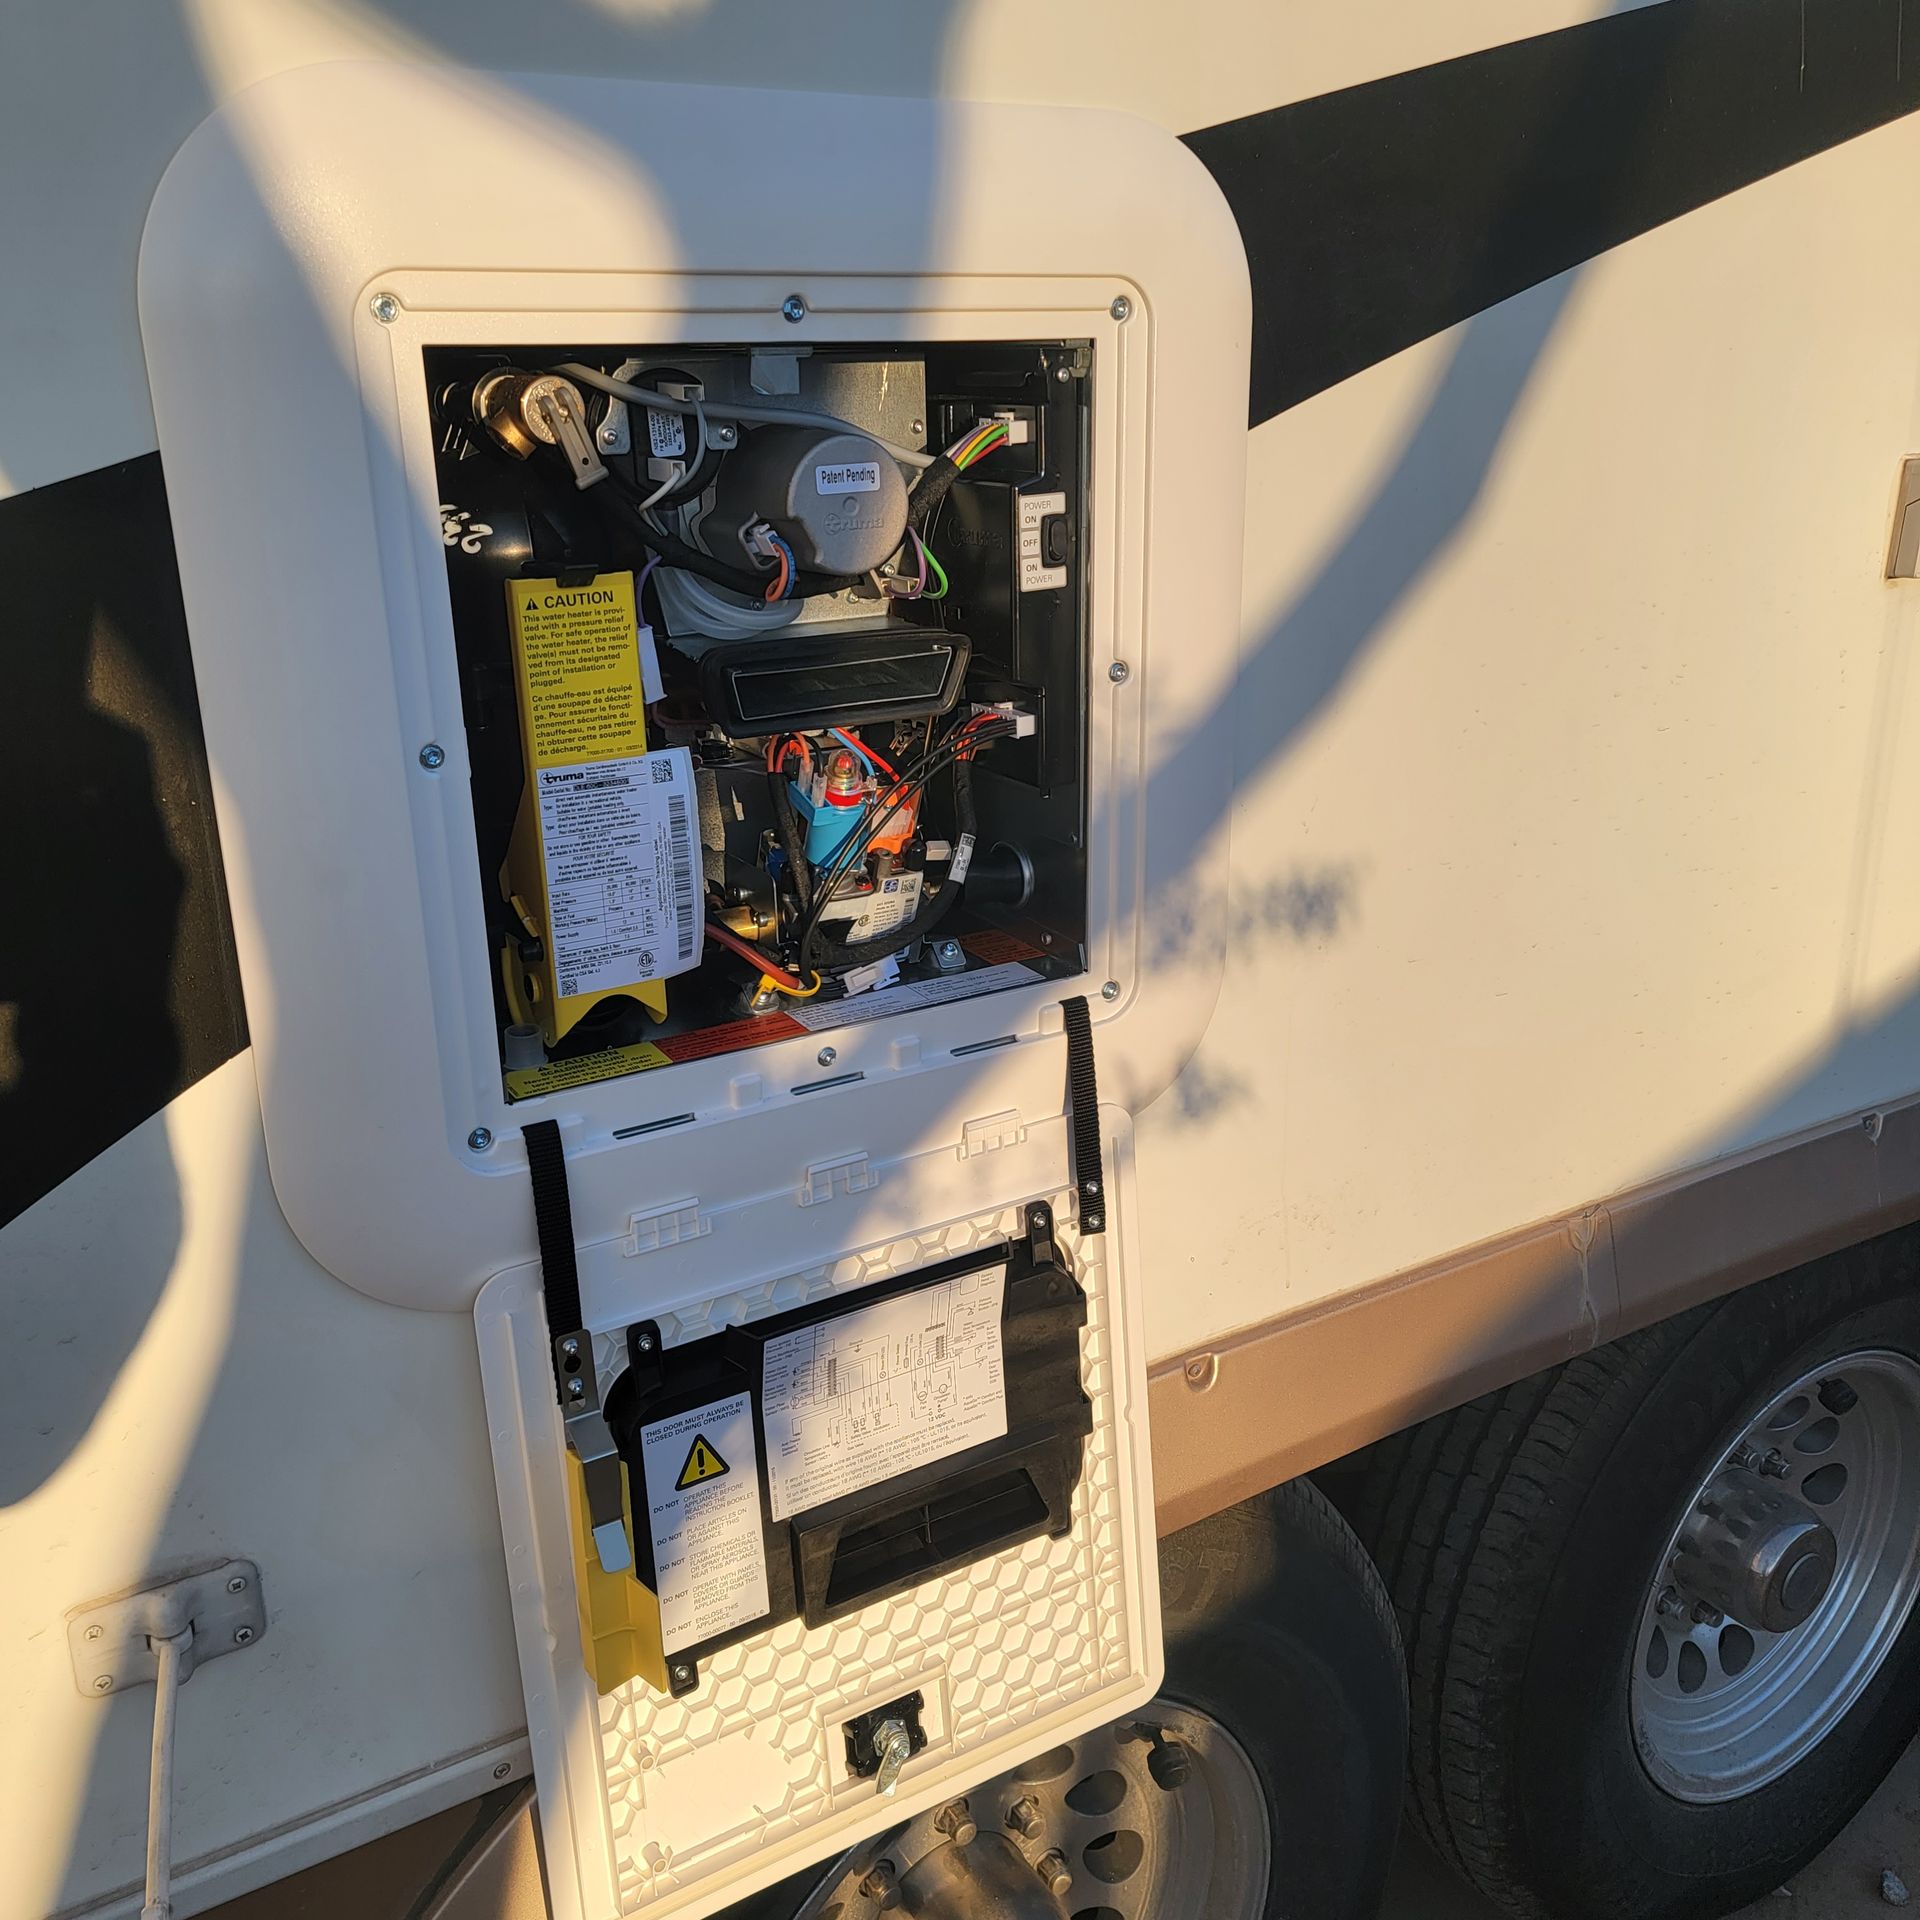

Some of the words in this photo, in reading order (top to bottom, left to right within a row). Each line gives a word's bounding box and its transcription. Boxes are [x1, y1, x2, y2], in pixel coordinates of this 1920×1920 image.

[822, 469, 844, 484] Patent
[846, 468, 875, 483] Pending
[1025, 501, 1051, 510] POWER
[1026, 564, 1037, 572] ON
[1026, 575, 1052, 584] POWER
[544, 591, 613, 608] CAUTION
[603, 607, 625, 616] provi-
[524, 624, 539, 632] ded
[569, 619, 602, 628] pressure
[604, 615, 624, 624] relief
[584, 626, 621, 636] operation
[527, 650, 556, 659] valve(s)
[578, 652, 620, 663] designated
[529, 670, 550, 679] point
[563, 664, 605, 674] installation
[530, 677, 565, 688] plugged.
[545, 691, 591, 701] chauffe-eau
[607, 684, 632, 693] équipé
[558, 700, 590, 708] soupape
[569, 708, 597, 716] assurer
[608, 702, 632, 710] foncti-
[535, 719, 575, 729] onnement
[577, 713, 617, 724] sécuritaire
[536, 728, 584, 738] chauffe-eau,
[547, 737, 575, 746] obturer
[599, 730, 631, 738] soupape
[550, 745, 588, 754] décharge.
[543, 771, 584, 784] truma
[540, 1063, 589, 1076] SCALDING
[591, 1055, 624, 1065] INJURY
[553, 1050, 620, 1067] CAUTION
[646, 1429, 661, 1438] THIS
[664, 1421, 683, 1432] DOOR
[685, 1414, 704, 1424] MUST
[706, 1404, 733, 1417] ALWAYS
[935, 1412, 946, 1420] VDC
[646, 1431, 673, 1445] CLOSED
[675, 1421, 702, 1435] DURING
[703, 1408, 740, 1425] OPERATION
[654, 1505, 664, 1514] DO
[665, 1499, 679, 1509] NOT
[684, 1488, 711, 1502] OPERATE
[713, 1482, 726, 1491] THIS
[684, 1492, 718, 1509] APPLIANCE
[720, 1482, 743, 1495] BEFORE
[685, 1501, 712, 1515] READING
[714, 1495, 726, 1504] THE
[686, 1503, 725, 1522] INSTRUCTION
[727, 1491, 753, 1506] BOOKLET.
[669, 1532, 682, 1541] NOT
[687, 1522, 706, 1535] PLACE
[709, 1511, 736, 1525] ARTICLES
[698, 1523, 724, 1537] AGAINST
[726, 1516, 740, 1526] THIS
[688, 1531, 723, 1548] APPLIANCE.
[660, 1564, 670, 1572] DO
[671, 1558, 685, 1567] NOT
[690, 1549, 708, 1560] STORE
[710, 1534, 746, 1552] CHEMICALS
[690, 1549, 724, 1567] FLAMMABLE
[726, 1536, 758, 1552] MATERIALS,
[701, 1557, 720, 1569] SPRAY
[722, 1544, 753, 1561] AEROSOLS
[691, 1569, 708, 1580] NEAR
[710, 1563, 723, 1572] THIS
[725, 1549, 759, 1566] APPLIANCE.
[663, 1596, 673, 1604] DO
[675, 1590, 688, 1599] NOT
[693, 1578, 718, 1592] OPERATE
[720, 1572, 736, 1581] WITH
[737, 1561, 760, 1575] PANELS,
[693, 1585, 718, 1598] COVERS
[730, 1570, 754, 1584] GUARDS
[694, 1589, 725, 1605] REMOVED
[726, 1581, 744, 1592] FROM
[745, 1575, 758, 1584] THIS
[694, 1594, 728, 1611] APPLIANCE.
[666, 1627, 676, 1636] DO
[678, 1621, 691, 1631] NOT
[696, 1608, 723, 1624] ENCLOSE
[726, 1602, 739, 1611] THIS
[696, 1612, 731, 1630] APPLIANCE.
